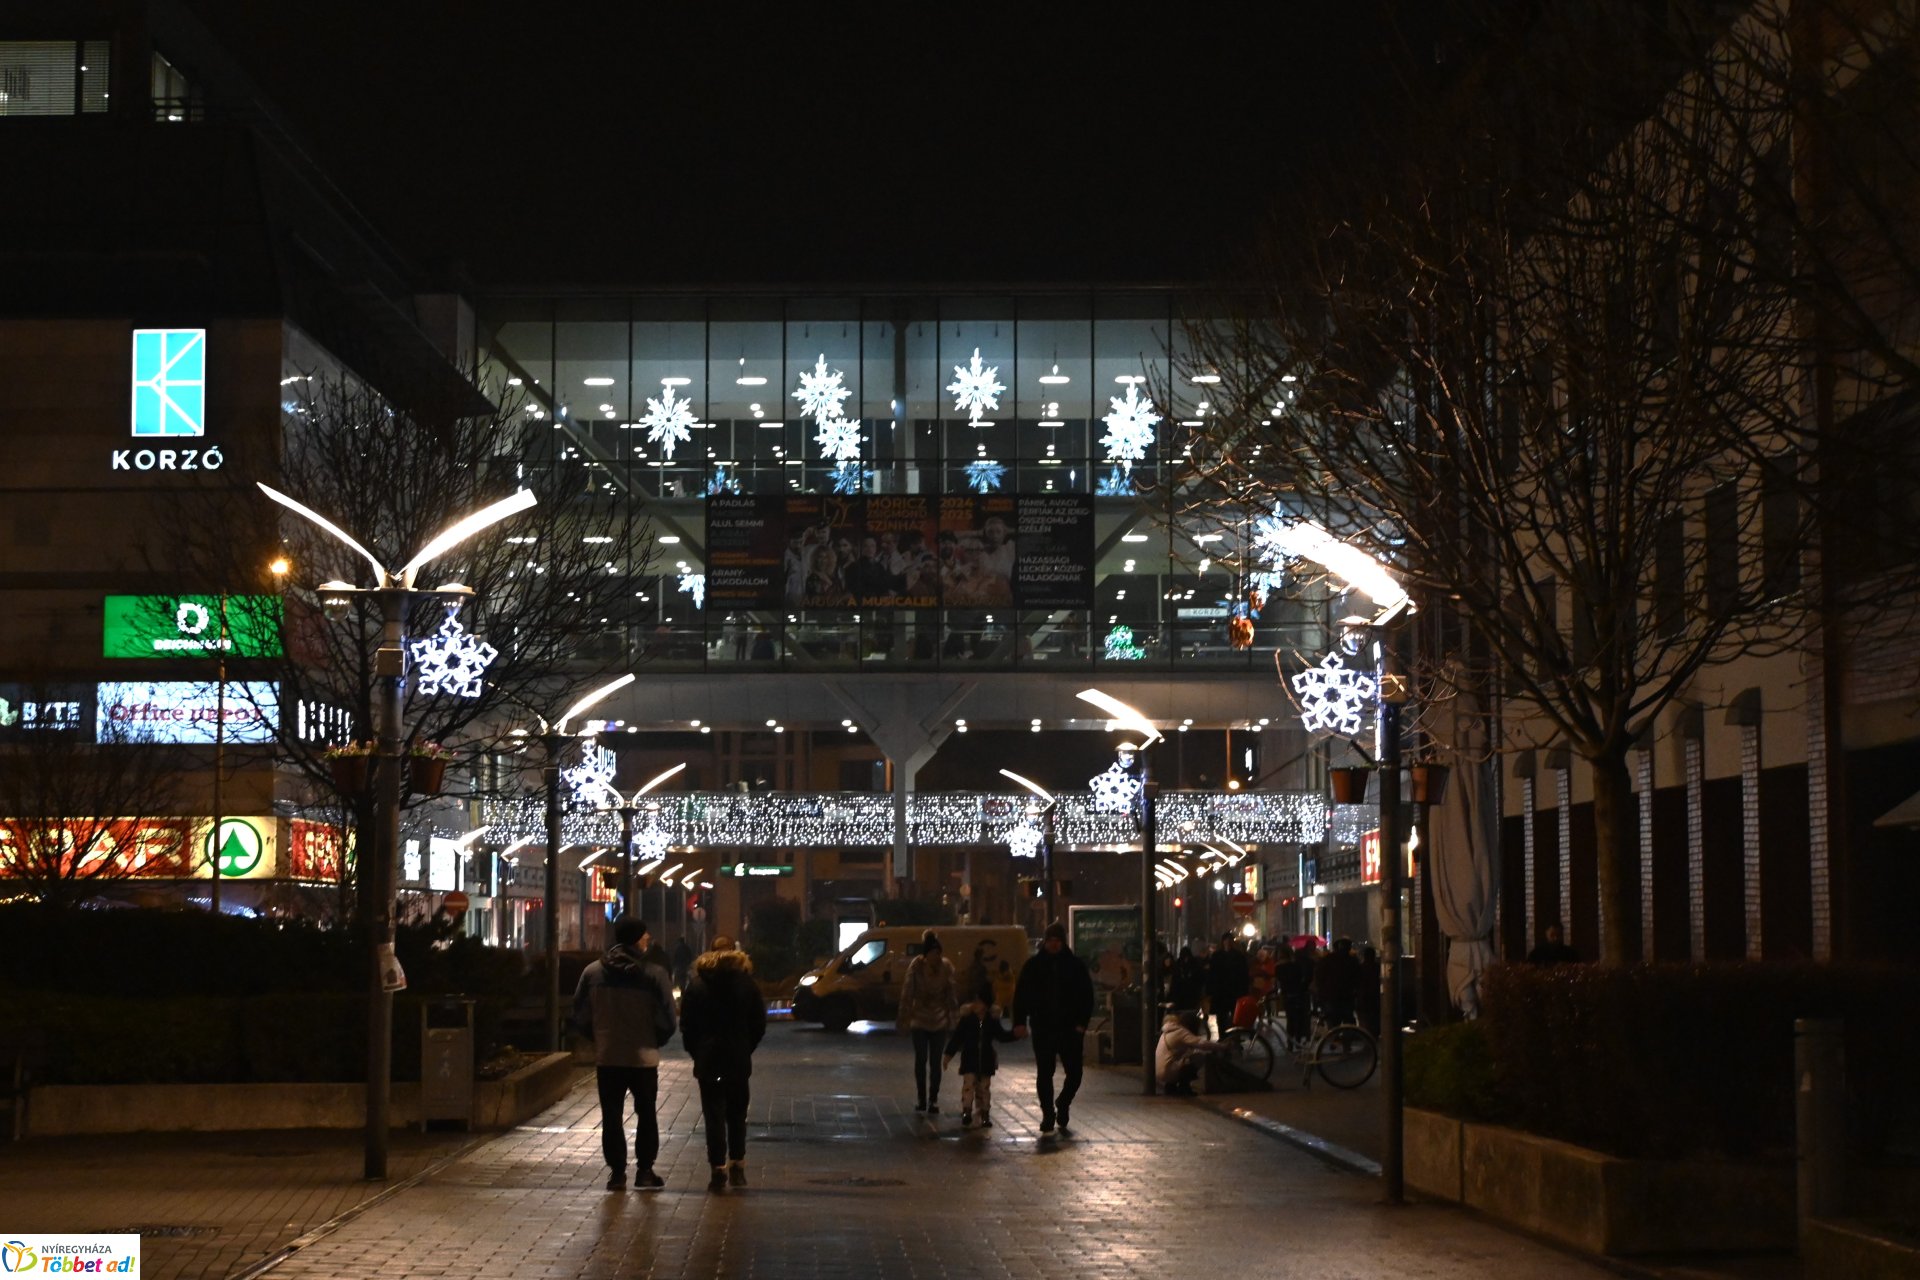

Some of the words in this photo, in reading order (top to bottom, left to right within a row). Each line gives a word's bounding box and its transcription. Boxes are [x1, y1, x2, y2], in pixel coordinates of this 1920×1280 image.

[113, 446, 223, 470] KORZÓ
[939, 498, 975, 508] 2024
[939, 509, 973, 519] 2025
[711, 577, 769, 586] LAKODALOM
[863, 596, 938, 607] MUSICALEK
[108, 703, 183, 721] Office
